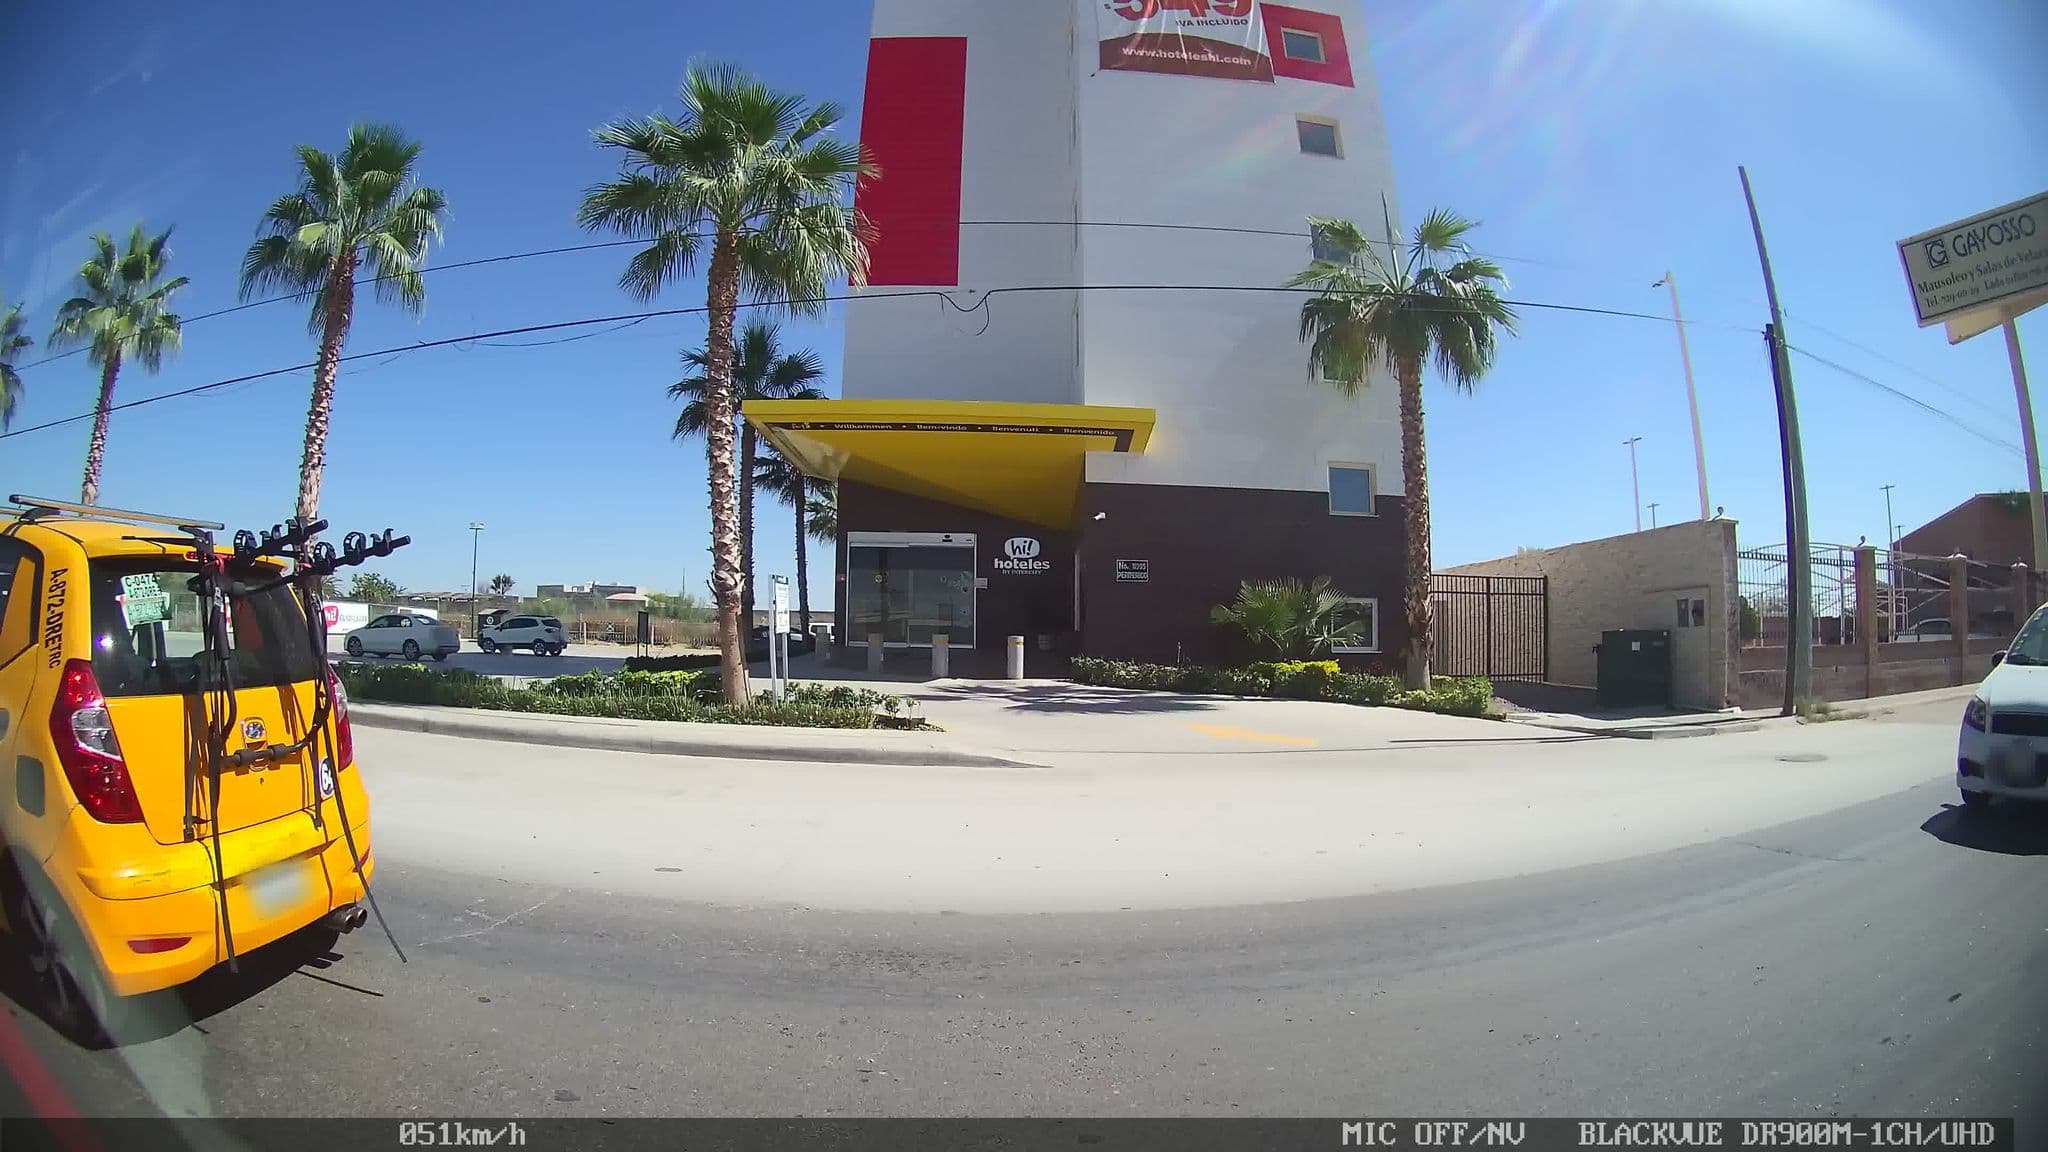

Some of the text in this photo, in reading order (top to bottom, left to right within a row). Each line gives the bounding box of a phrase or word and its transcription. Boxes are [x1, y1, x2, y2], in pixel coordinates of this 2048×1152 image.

[1197, 18, 1249, 27] INCLUIDO
[1122, 47, 1252, 66] www.hoteleshi.com
[1952, 213, 2036, 257] GAYOSSO
[1917, 271, 1968, 294] Mausoleo
[1011, 539, 1034, 556] hi!
[993, 557, 1051, 570] hoteles
